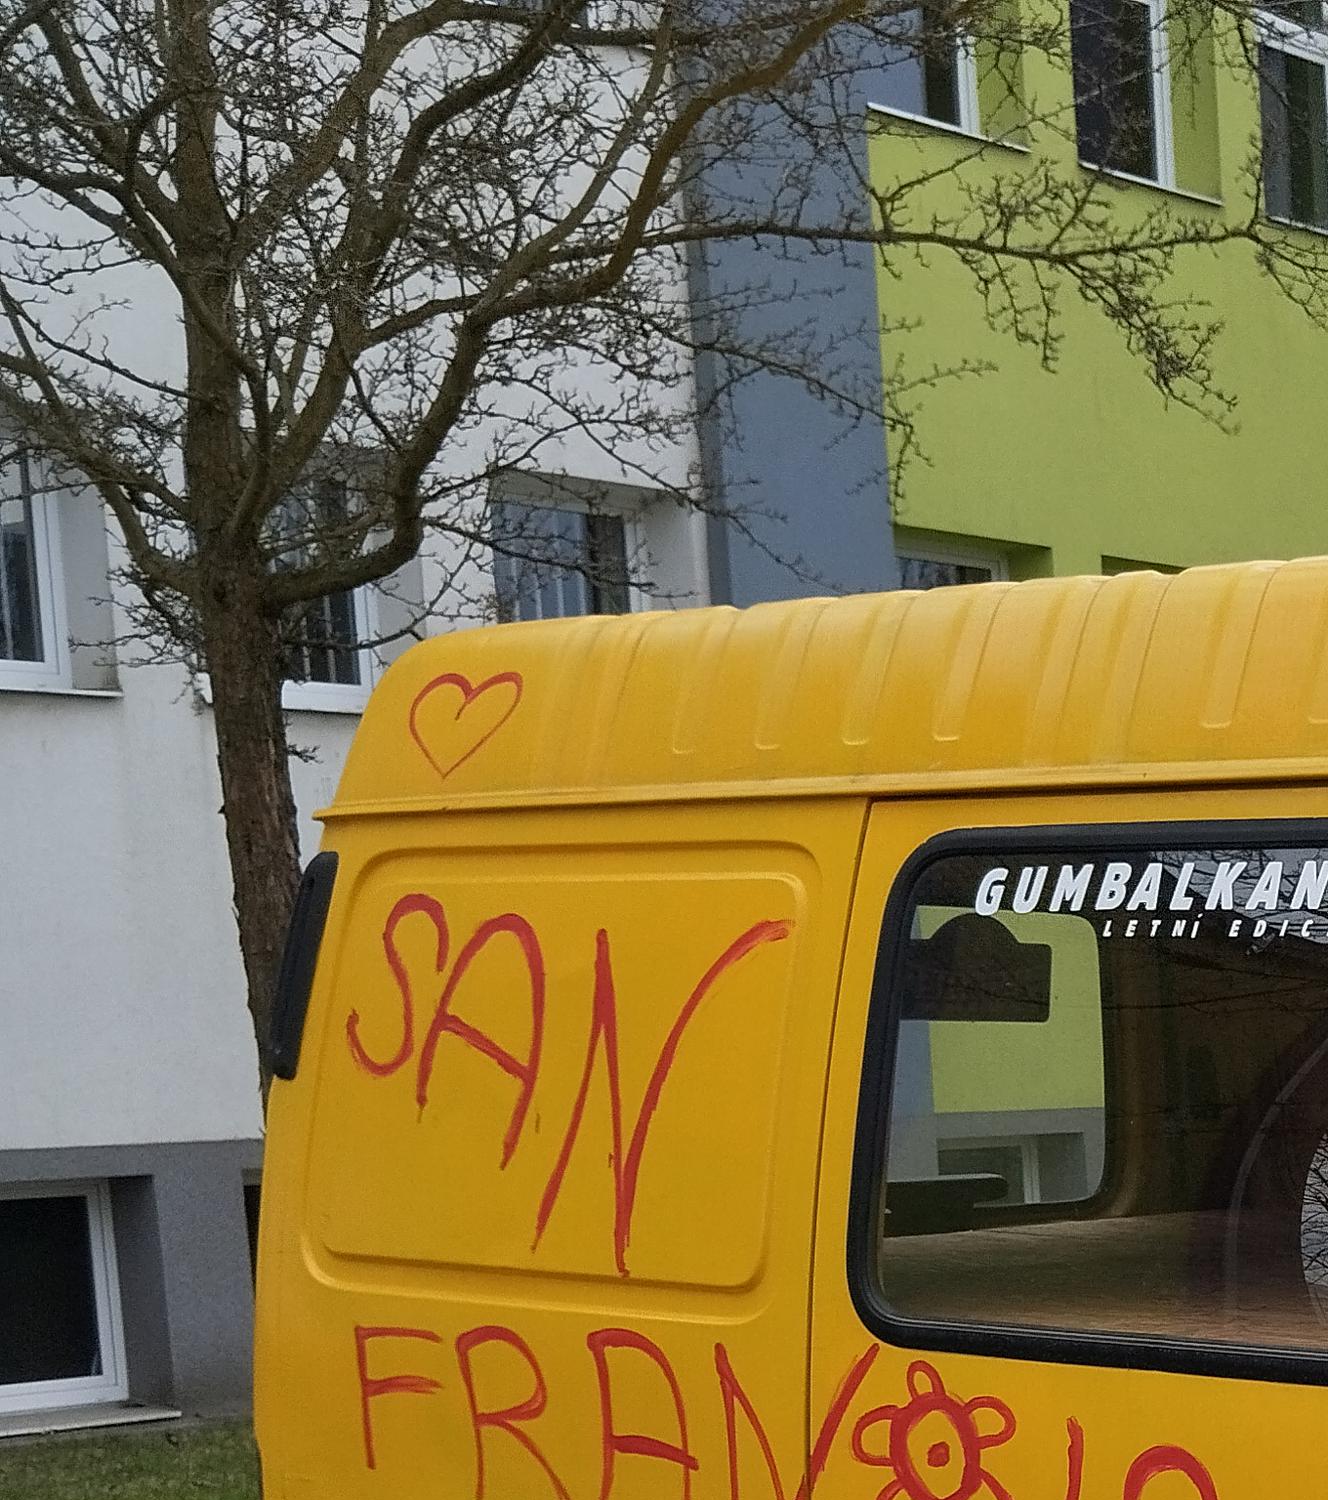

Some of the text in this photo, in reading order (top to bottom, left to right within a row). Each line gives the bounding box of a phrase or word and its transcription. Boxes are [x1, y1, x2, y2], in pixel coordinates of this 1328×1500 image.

[974, 862, 1328, 916] GUMBALKAN
[1102, 913, 1203, 938] LETNÍ
[346, 893, 793, 1279] SAN
